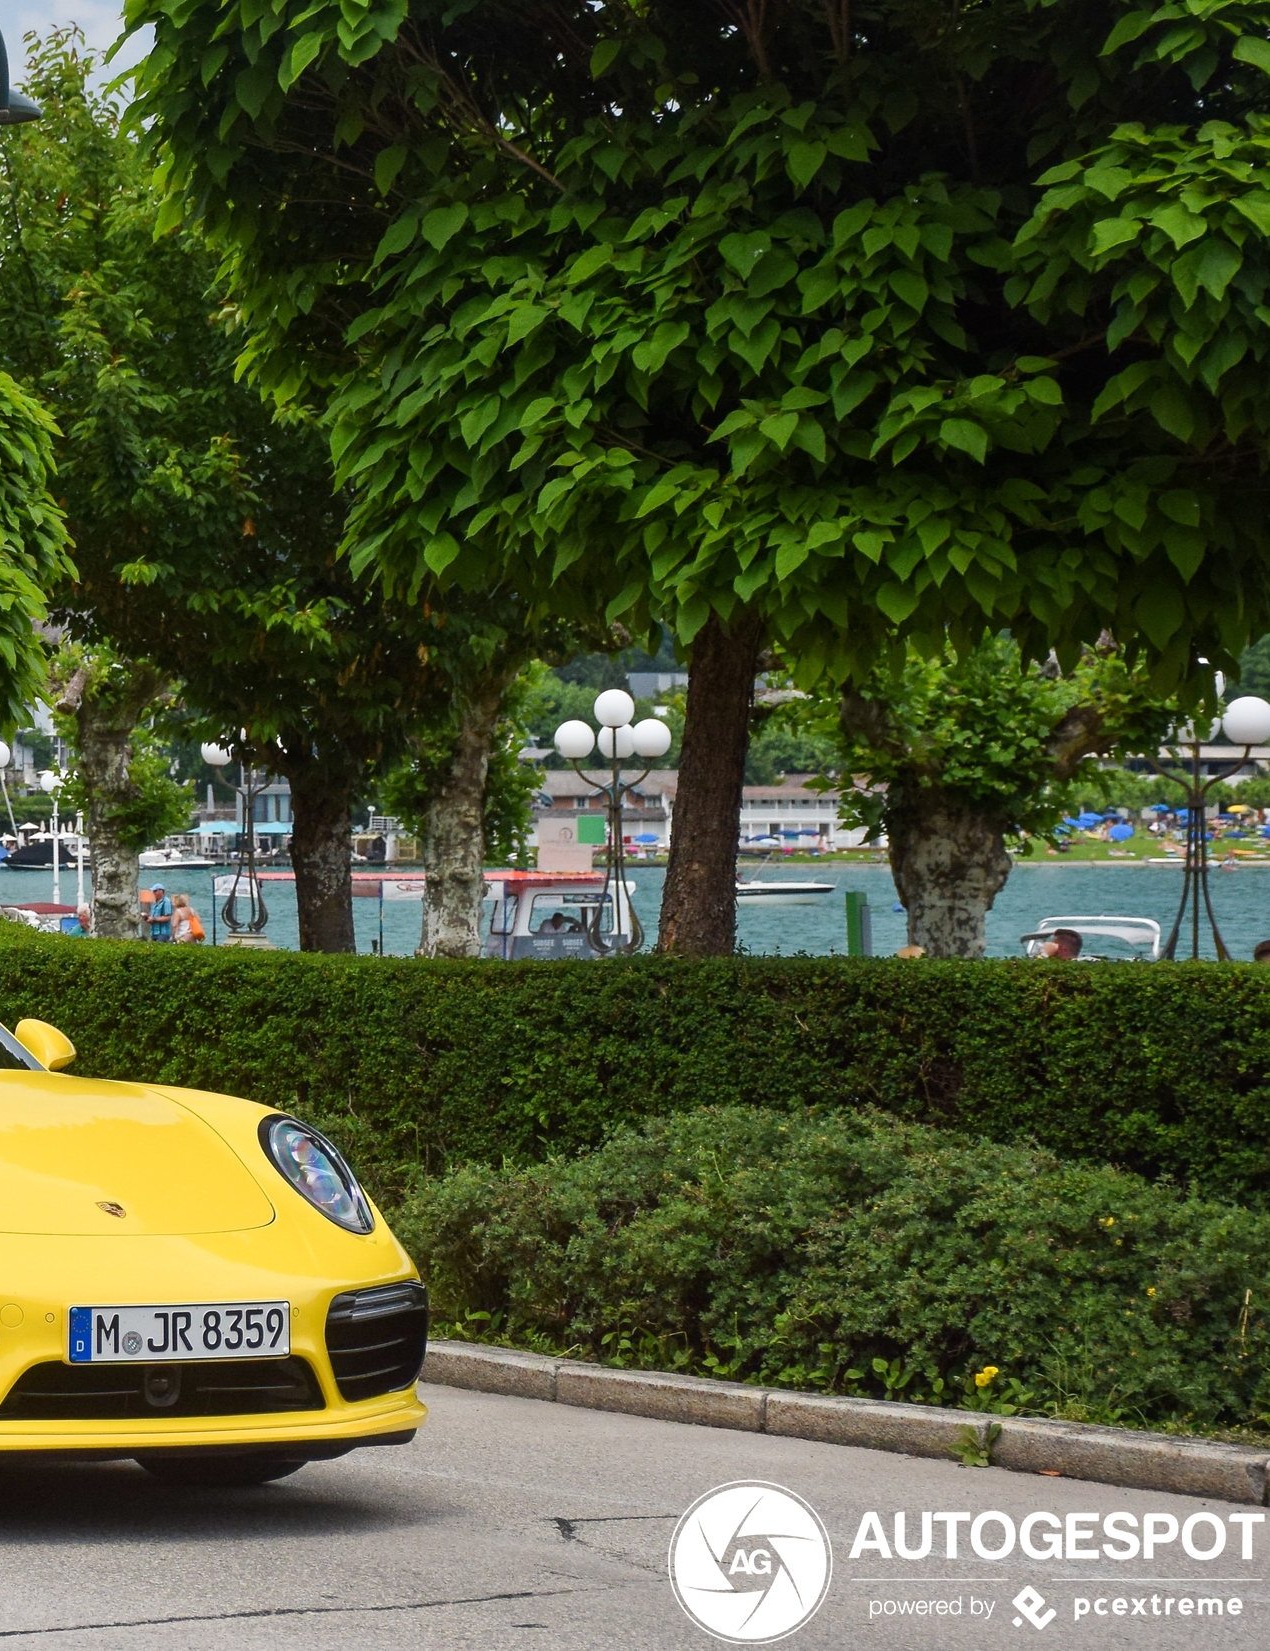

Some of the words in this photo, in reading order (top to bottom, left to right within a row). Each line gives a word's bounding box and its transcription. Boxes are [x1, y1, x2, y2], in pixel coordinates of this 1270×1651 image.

[76, 1340, 85, 1352] D
[96, 1313, 120, 1354] M
[147, 1311, 194, 1353] JR
[202, 1308, 284, 1351] 8359
